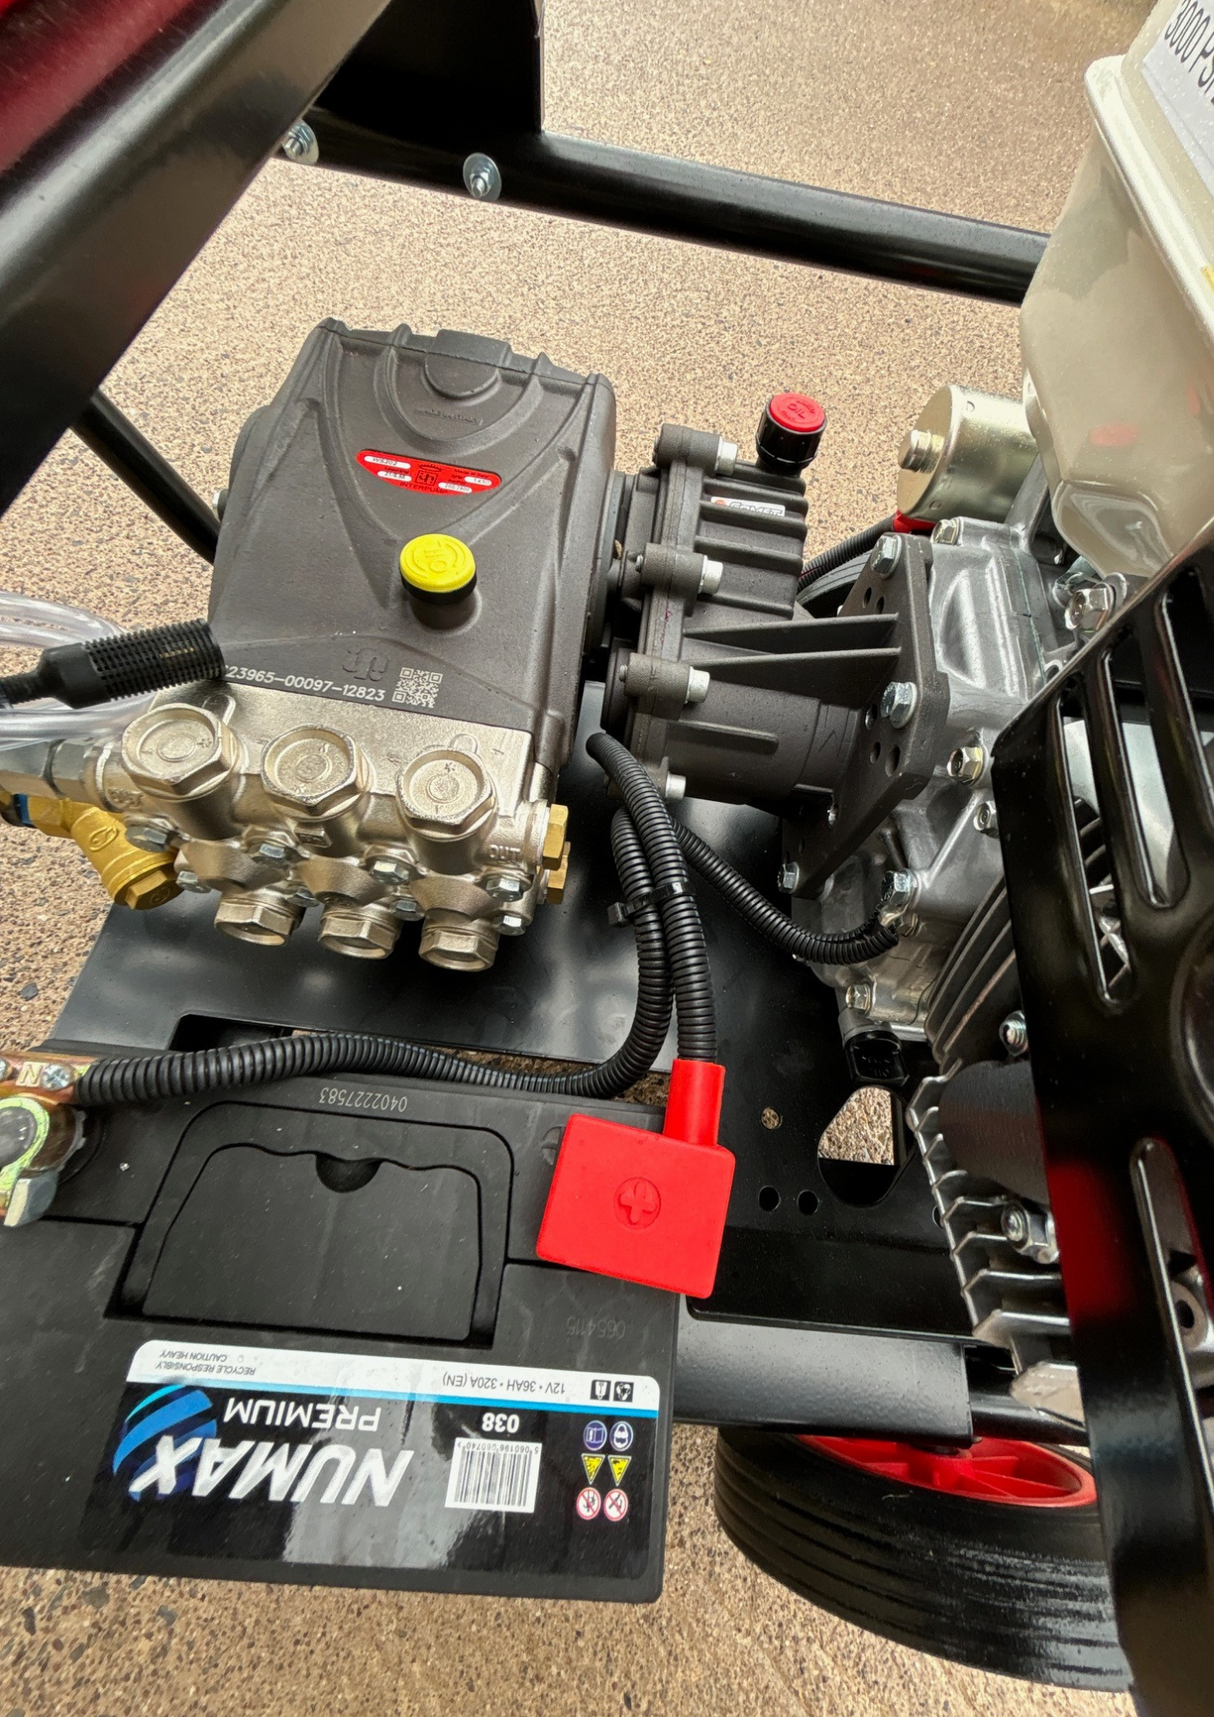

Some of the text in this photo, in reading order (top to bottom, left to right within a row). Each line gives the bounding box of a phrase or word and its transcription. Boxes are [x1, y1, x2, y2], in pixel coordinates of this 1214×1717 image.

[1164, 0, 1211, 63] 3000
[224, 664, 386, 702] 23965-00097-12823
[318, 1086, 408, 1113] 0402227583
[155, 1360, 256, 1376] RECYCLE RESPONSIBLY
[159, 1350, 228, 1362] CAUTION HEAVY
[442, 1373, 566, 1394] 12V 36AH 320A (EN)
[223, 1397, 381, 1432] PREMIUM
[481, 1412, 520, 1434] 038
[128, 1434, 415, 1507] NUMAX
